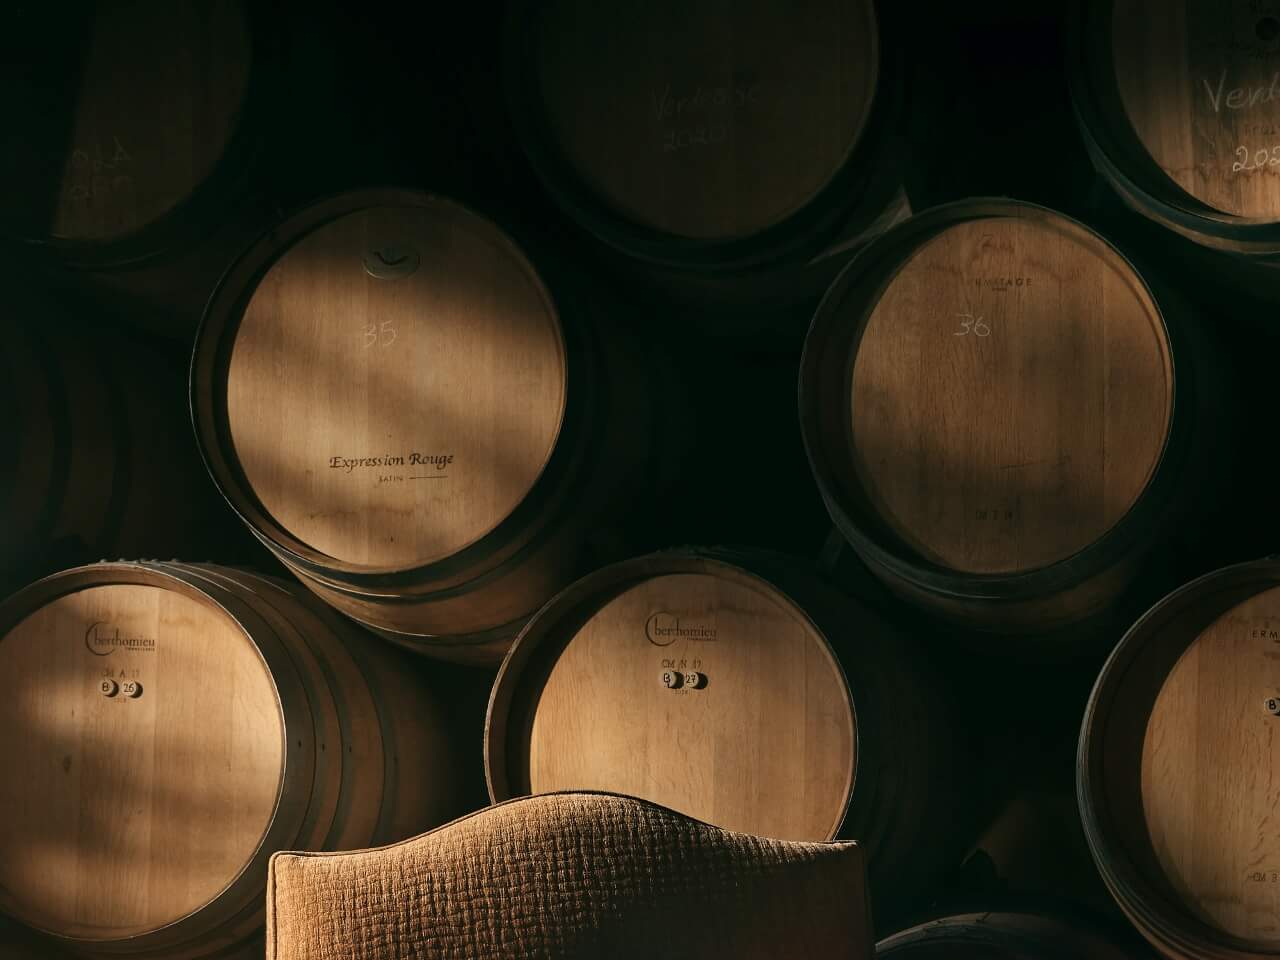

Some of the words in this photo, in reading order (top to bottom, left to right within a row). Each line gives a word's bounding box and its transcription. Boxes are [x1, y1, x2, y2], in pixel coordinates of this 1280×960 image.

[361, 320, 399, 348] 35
[953, 313, 993, 337] 36
[329, 454, 404, 474] Expression
[408, 452, 455, 471] Rouge
